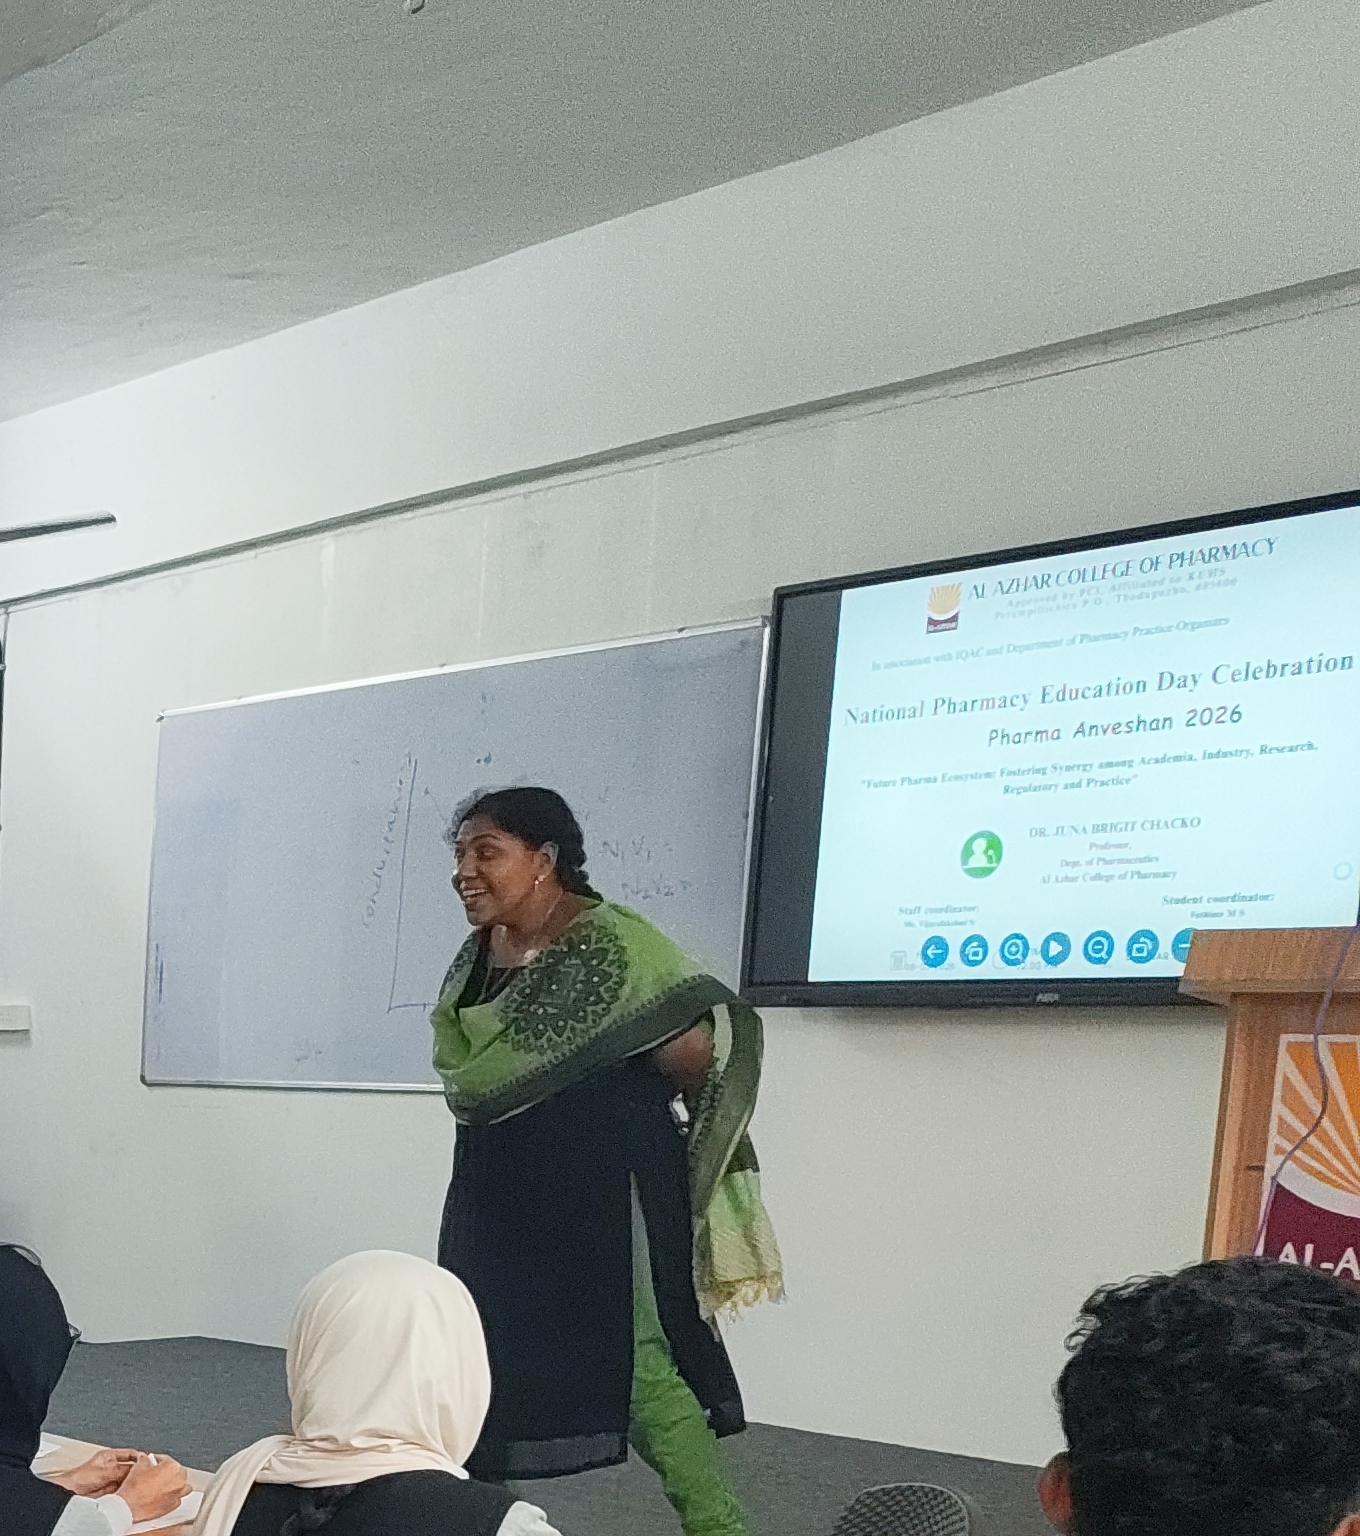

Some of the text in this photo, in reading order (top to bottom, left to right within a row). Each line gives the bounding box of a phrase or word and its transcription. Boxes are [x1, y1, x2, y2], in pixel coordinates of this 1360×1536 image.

[967, 536, 1280, 600] AL AZHAR COLLEGE OF PHARMACY
[933, 651, 954, 663] with
[955, 645, 984, 662] IQAC
[985, 644, 1005, 657] and
[1006, 636, 1064, 655] Department
[1065, 634, 1079, 647] of
[1079, 630, 1129, 645] Pharmacy
[1132, 623, 1175, 638] Practice
[844, 651, 1355, 727] National Pharmacy Education Day Celebration
[988, 703, 1243, 748] Pharma Anveshan 2026
[899, 774, 939, 788] Pharma
[999, 764, 1048, 779] Fostering
[1050, 761, 1094, 775] Synergy
[1097, 758, 1135, 770] among
[1137, 751, 1198, 767] Academia,
[1201, 747, 1255, 762] Industry,
[1258, 740, 1319, 756] Research,
[1002, 782, 1060, 796] Regulatory
[1062, 779, 1083, 791] and
[1052, 823, 1088, 838] JUNA
[1090, 819, 1138, 835] BRIGIT
[1140, 816, 1202, 832] CHACKO
[1161, 894, 1204, 907] Student
